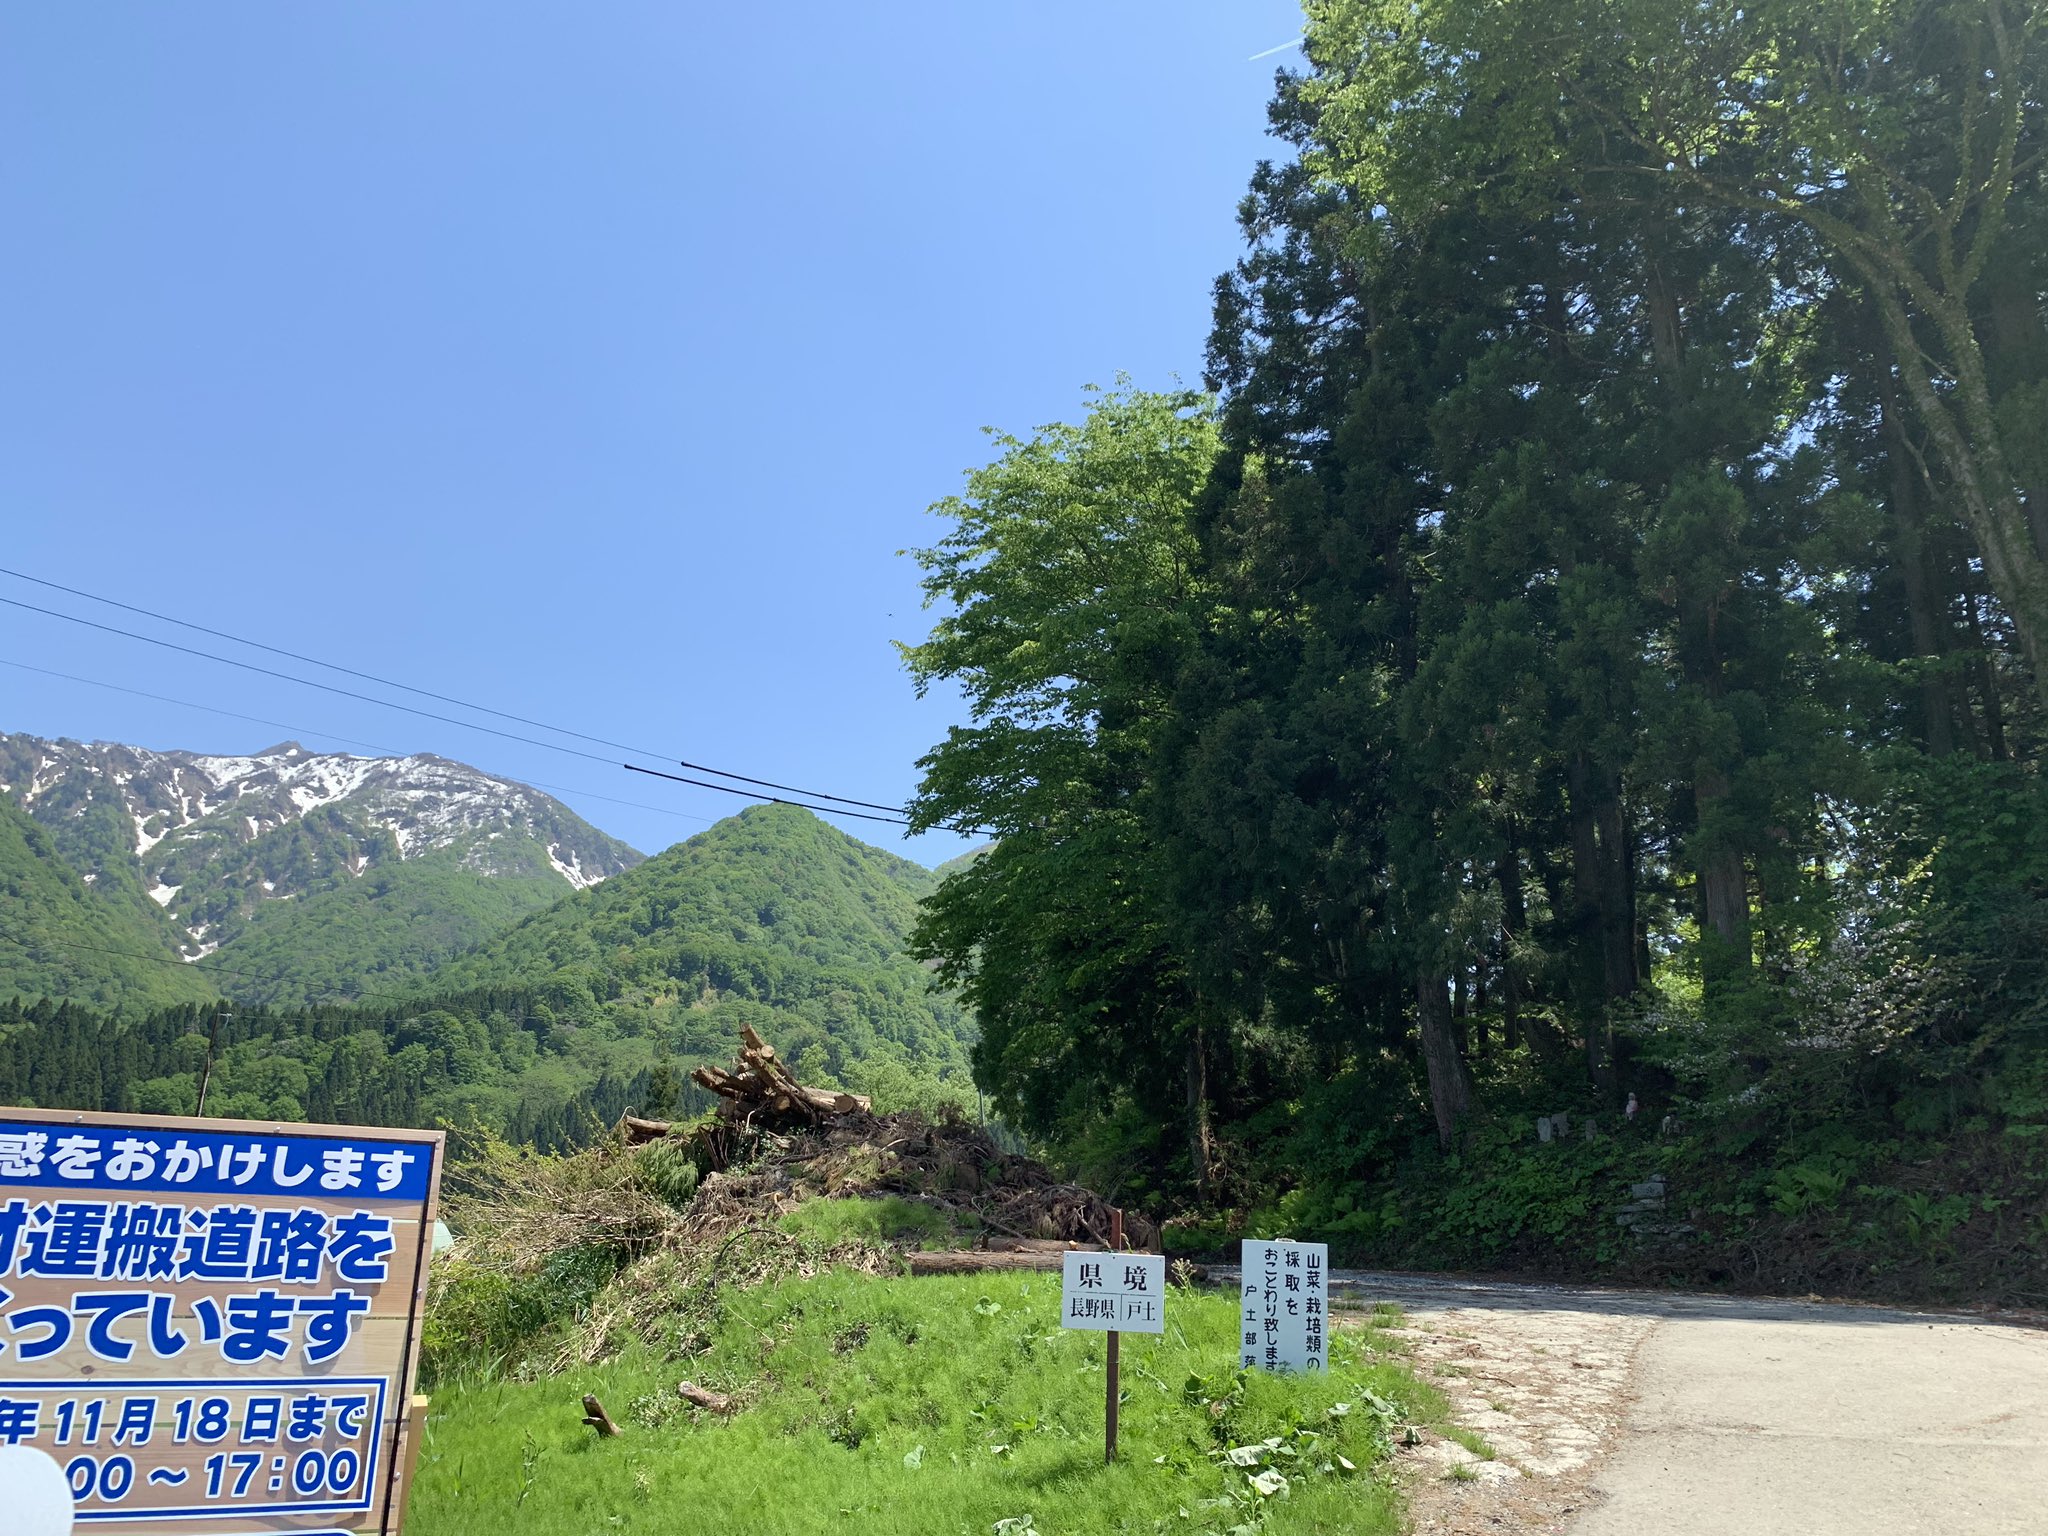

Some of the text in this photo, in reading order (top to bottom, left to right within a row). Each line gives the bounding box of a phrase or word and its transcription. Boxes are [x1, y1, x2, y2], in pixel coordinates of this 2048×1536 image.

[0, 1131, 416, 1192] 惑をおかけします
[1070, 1297, 1156, 1321] 長野県 戸土
[1285, 1251, 1300, 1315] 採取を
[0, 1289, 370, 1363] っています
